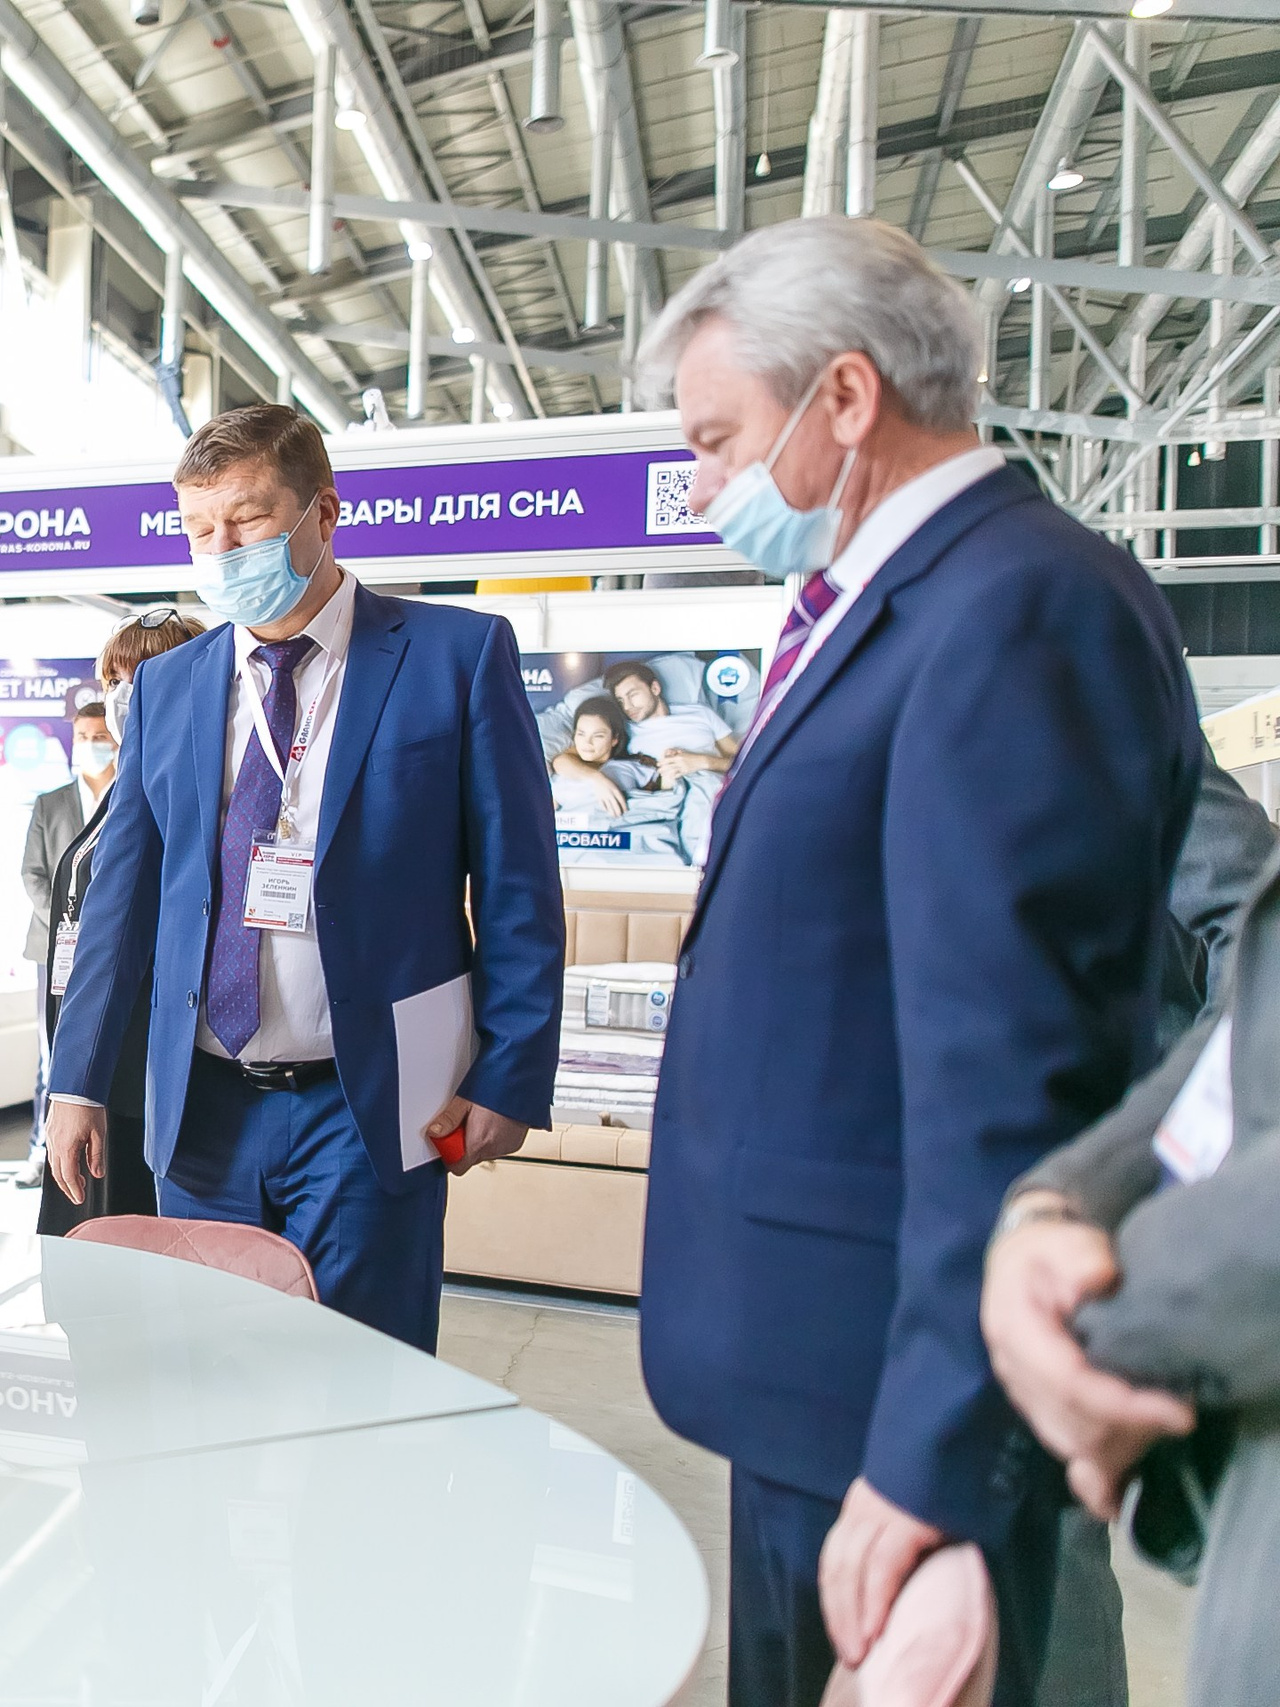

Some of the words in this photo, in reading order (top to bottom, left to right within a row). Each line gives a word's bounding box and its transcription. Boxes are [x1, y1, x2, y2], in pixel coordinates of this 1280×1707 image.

[140, 511, 187, 537] МЕ
[336, 497, 422, 527] ВАРЫ
[429, 491, 502, 526] ДЛЯ
[508, 488, 585, 518] СНА
[521, 668, 553, 685] НА
[556, 832, 622, 848] РОВАТИ
